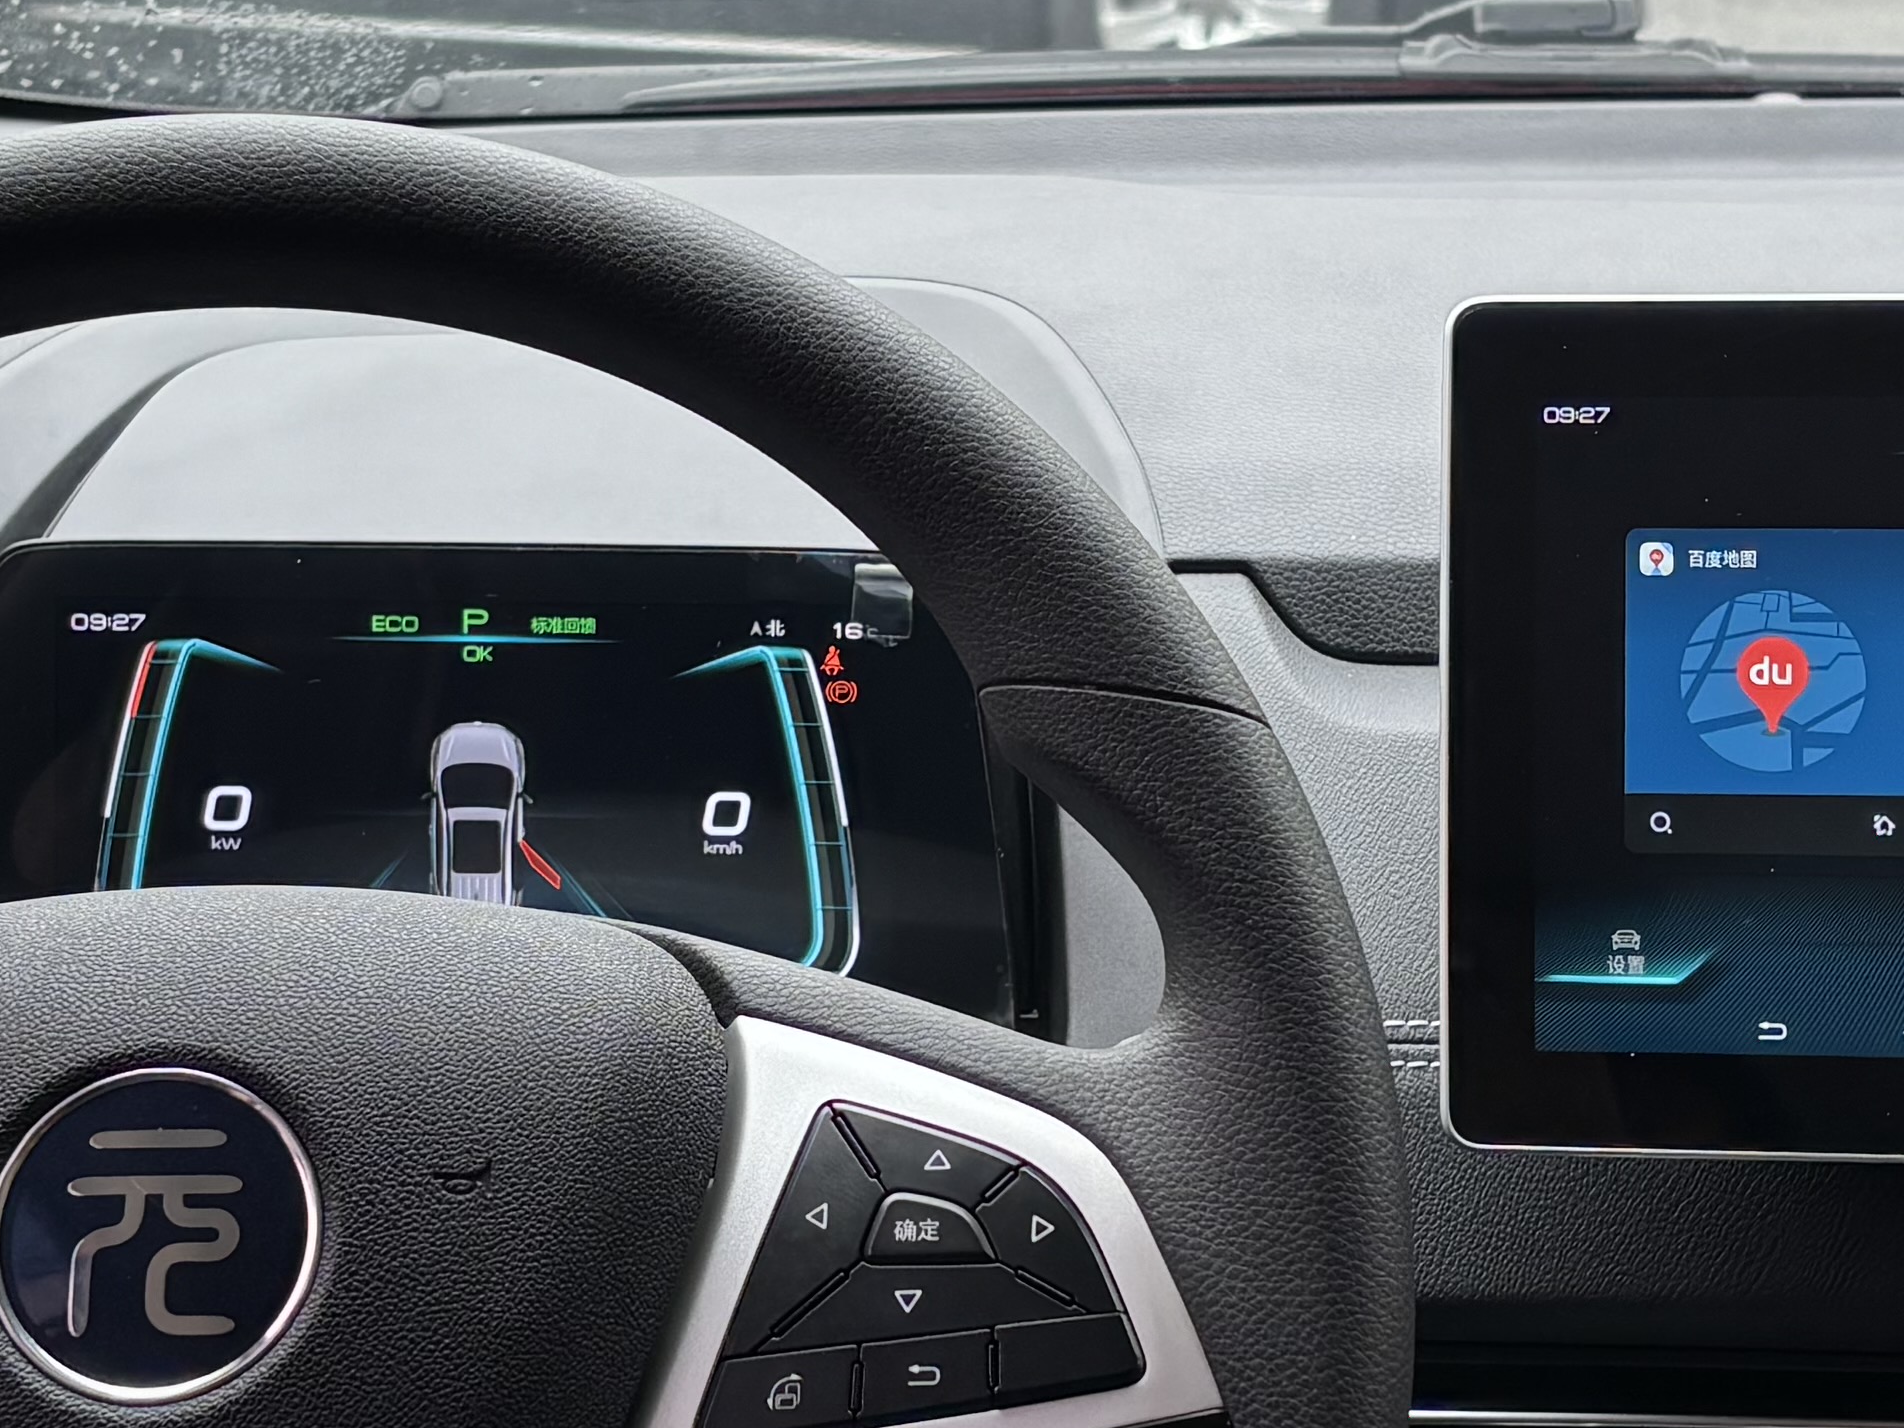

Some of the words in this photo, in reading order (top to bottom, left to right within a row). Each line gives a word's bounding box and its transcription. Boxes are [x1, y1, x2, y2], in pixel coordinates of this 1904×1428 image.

[1543, 406, 1610, 424] 09:27
[1688, 549, 1757, 569] 百度地图
[70, 613, 146, 632] 09:27
[371, 615, 419, 633] ECO
[462, 609, 489, 634] P
[766, 619, 785, 637] 北
[462, 645, 493, 662] OK
[1748, 655, 1793, 685] du
[203, 785, 252, 832] 0
[702, 791, 751, 837] 0
[211, 835, 242, 851] kW
[703, 840, 743, 856] km/h
[1607, 955, 1645, 975] 设置
[67, 1128, 243, 1338] 元
[894, 1218, 940, 1242] 确定
